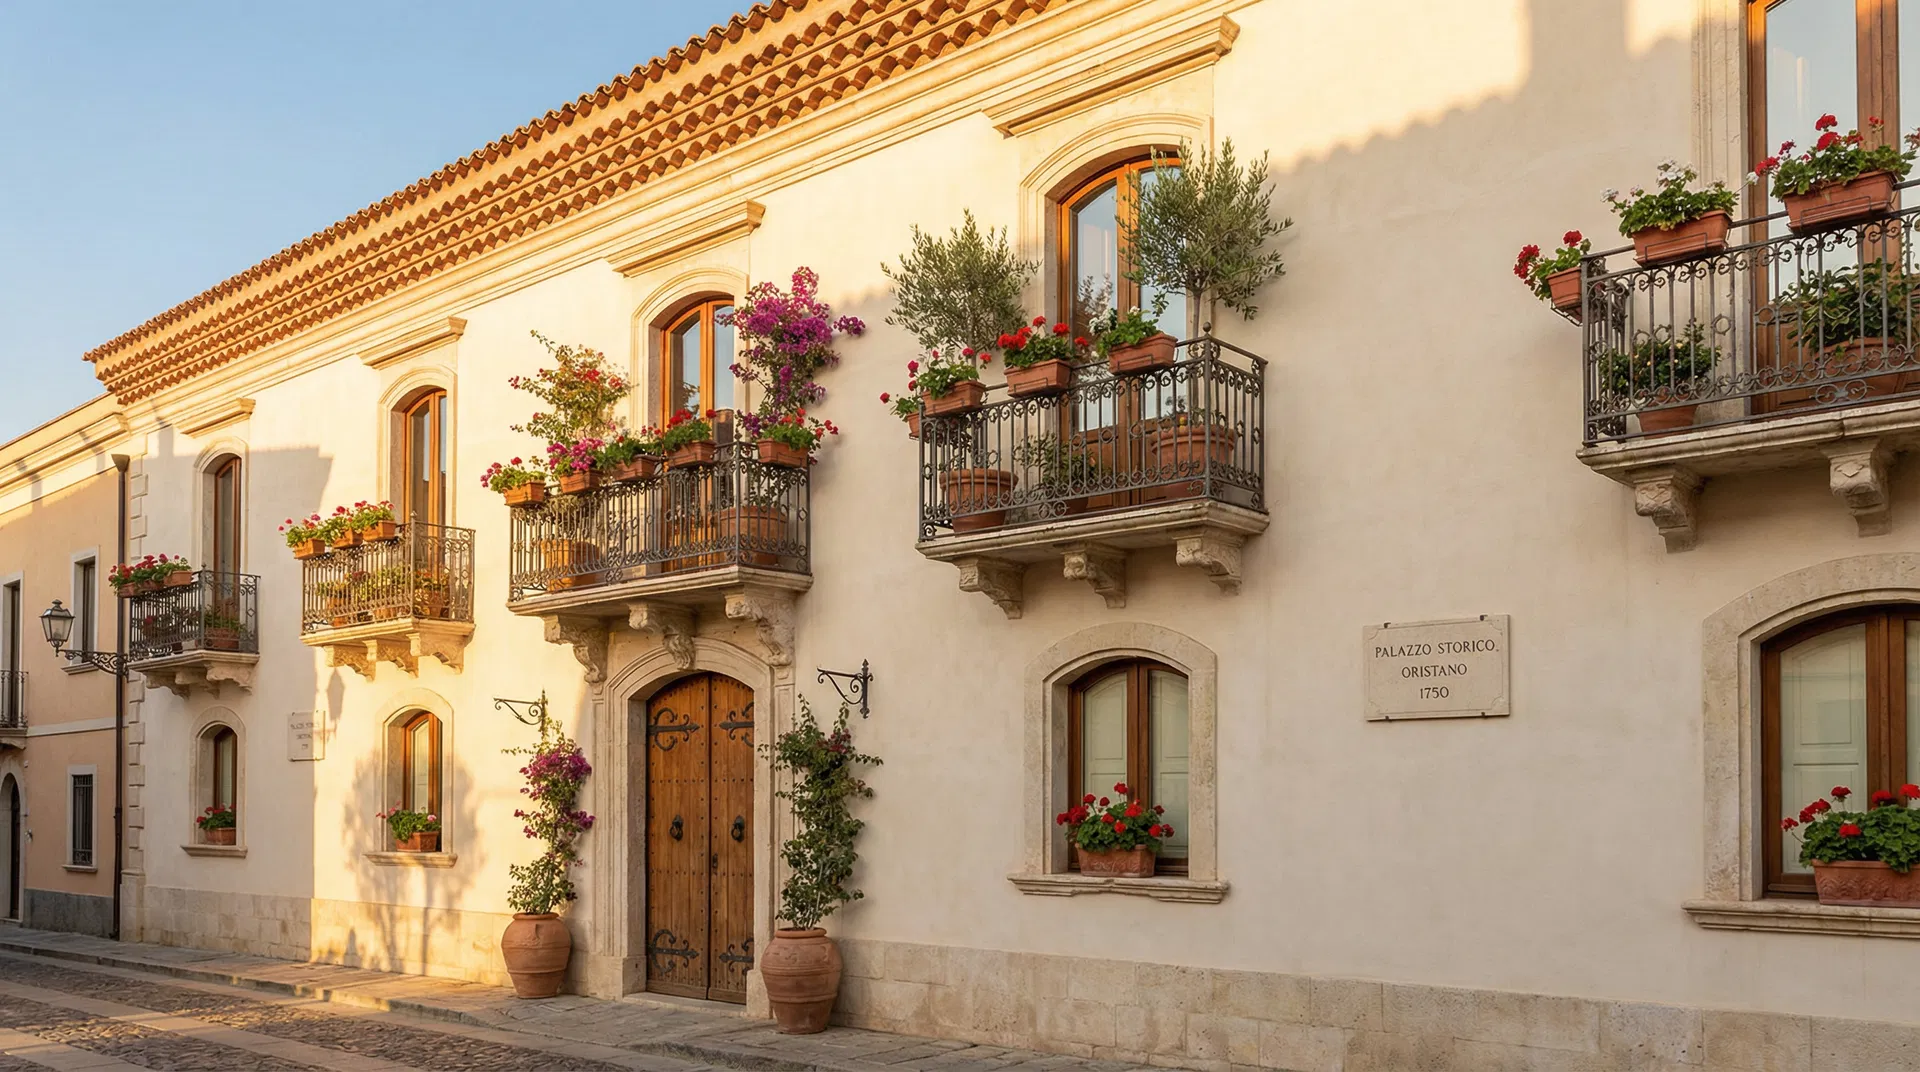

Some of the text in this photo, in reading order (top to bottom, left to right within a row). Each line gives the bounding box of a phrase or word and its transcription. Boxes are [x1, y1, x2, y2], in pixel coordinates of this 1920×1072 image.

[1375, 643, 1432, 658] PALAZZO
[1401, 663, 1467, 678] ORISTANO
[1420, 686, 1449, 699] 1750
